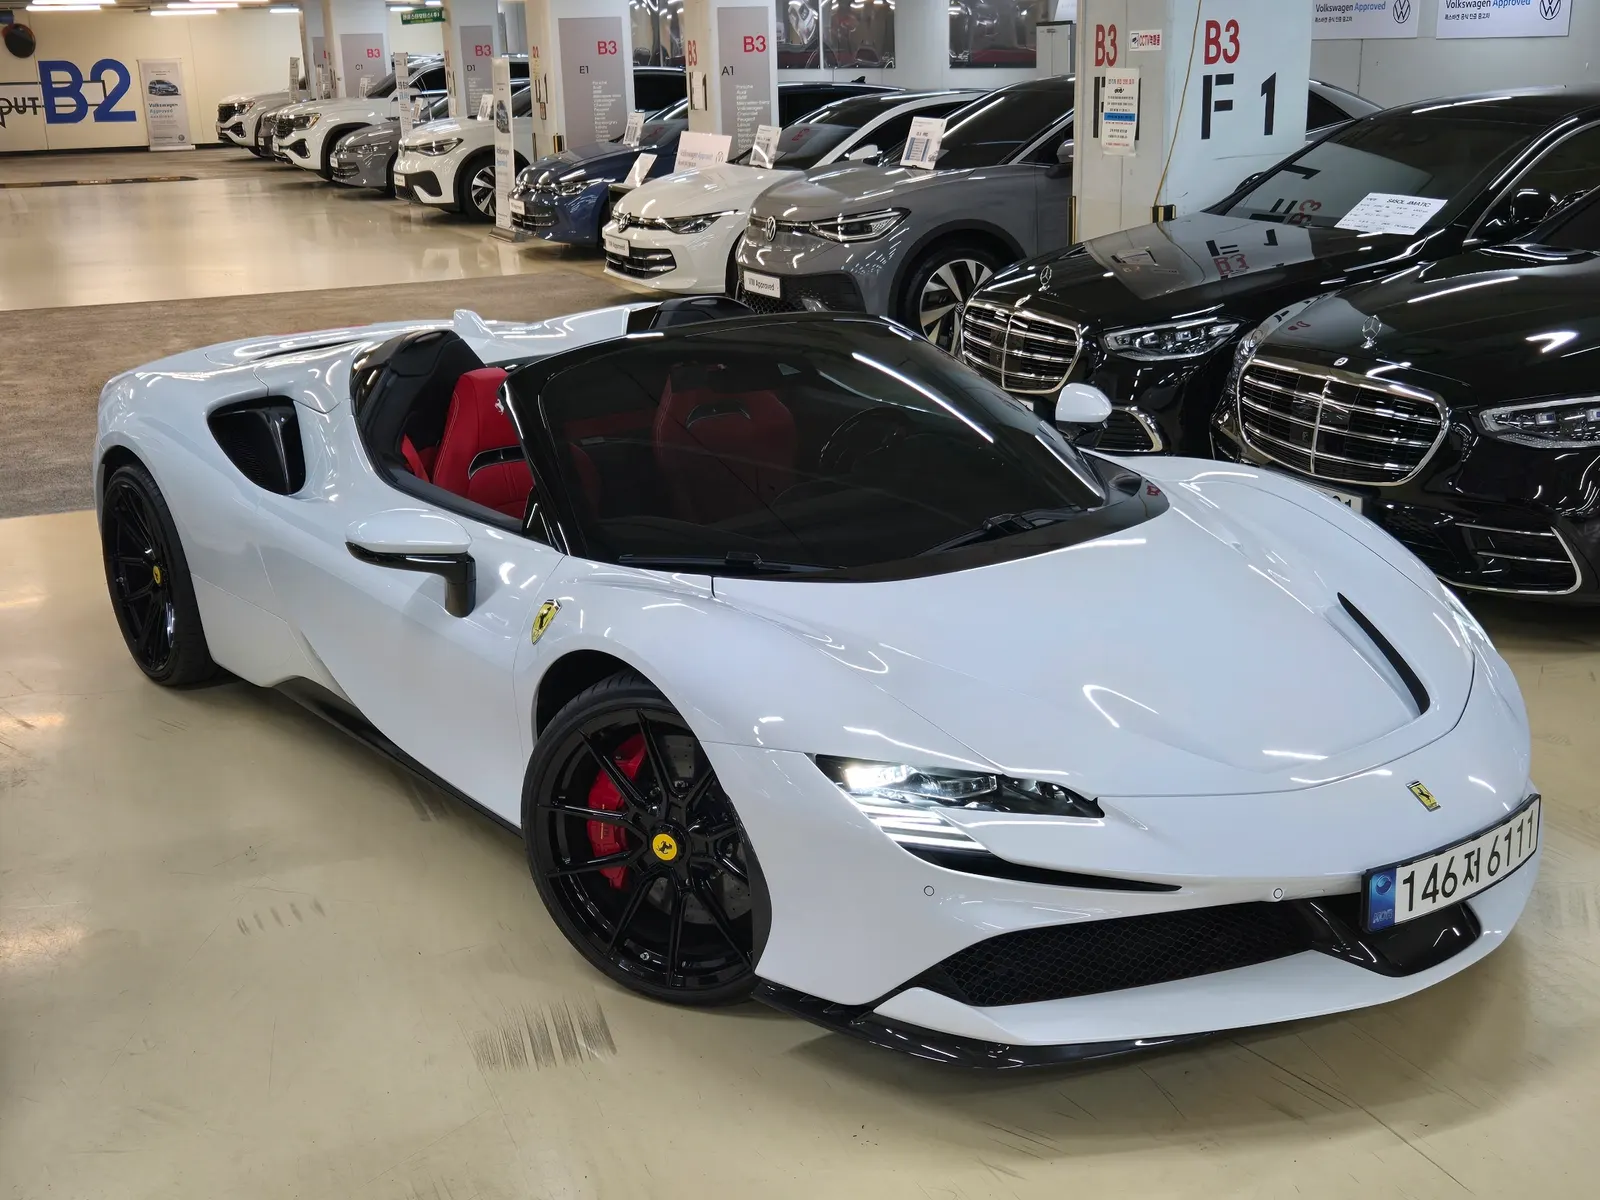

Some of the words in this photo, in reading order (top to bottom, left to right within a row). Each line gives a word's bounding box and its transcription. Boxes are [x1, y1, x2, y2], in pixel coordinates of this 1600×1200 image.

[1316, 4, 1353, 13] Volkswagen
[1354, 2, 1386, 12] Approved
[1446, 0, 1491, 10] Volkswagen
[598, 41, 617, 55] B3
[743, 35, 766, 53] B3
[1095, 24, 1117, 67] B3
[1204, 19, 1240, 65] B3
[366, 49, 380, 58] B3
[475, 45, 491, 57] B3
[688, 40, 697, 66] B3
[580, 66, 589, 74] E1
[722, 66, 734, 76] A1
[38, 58, 137, 124] B2
